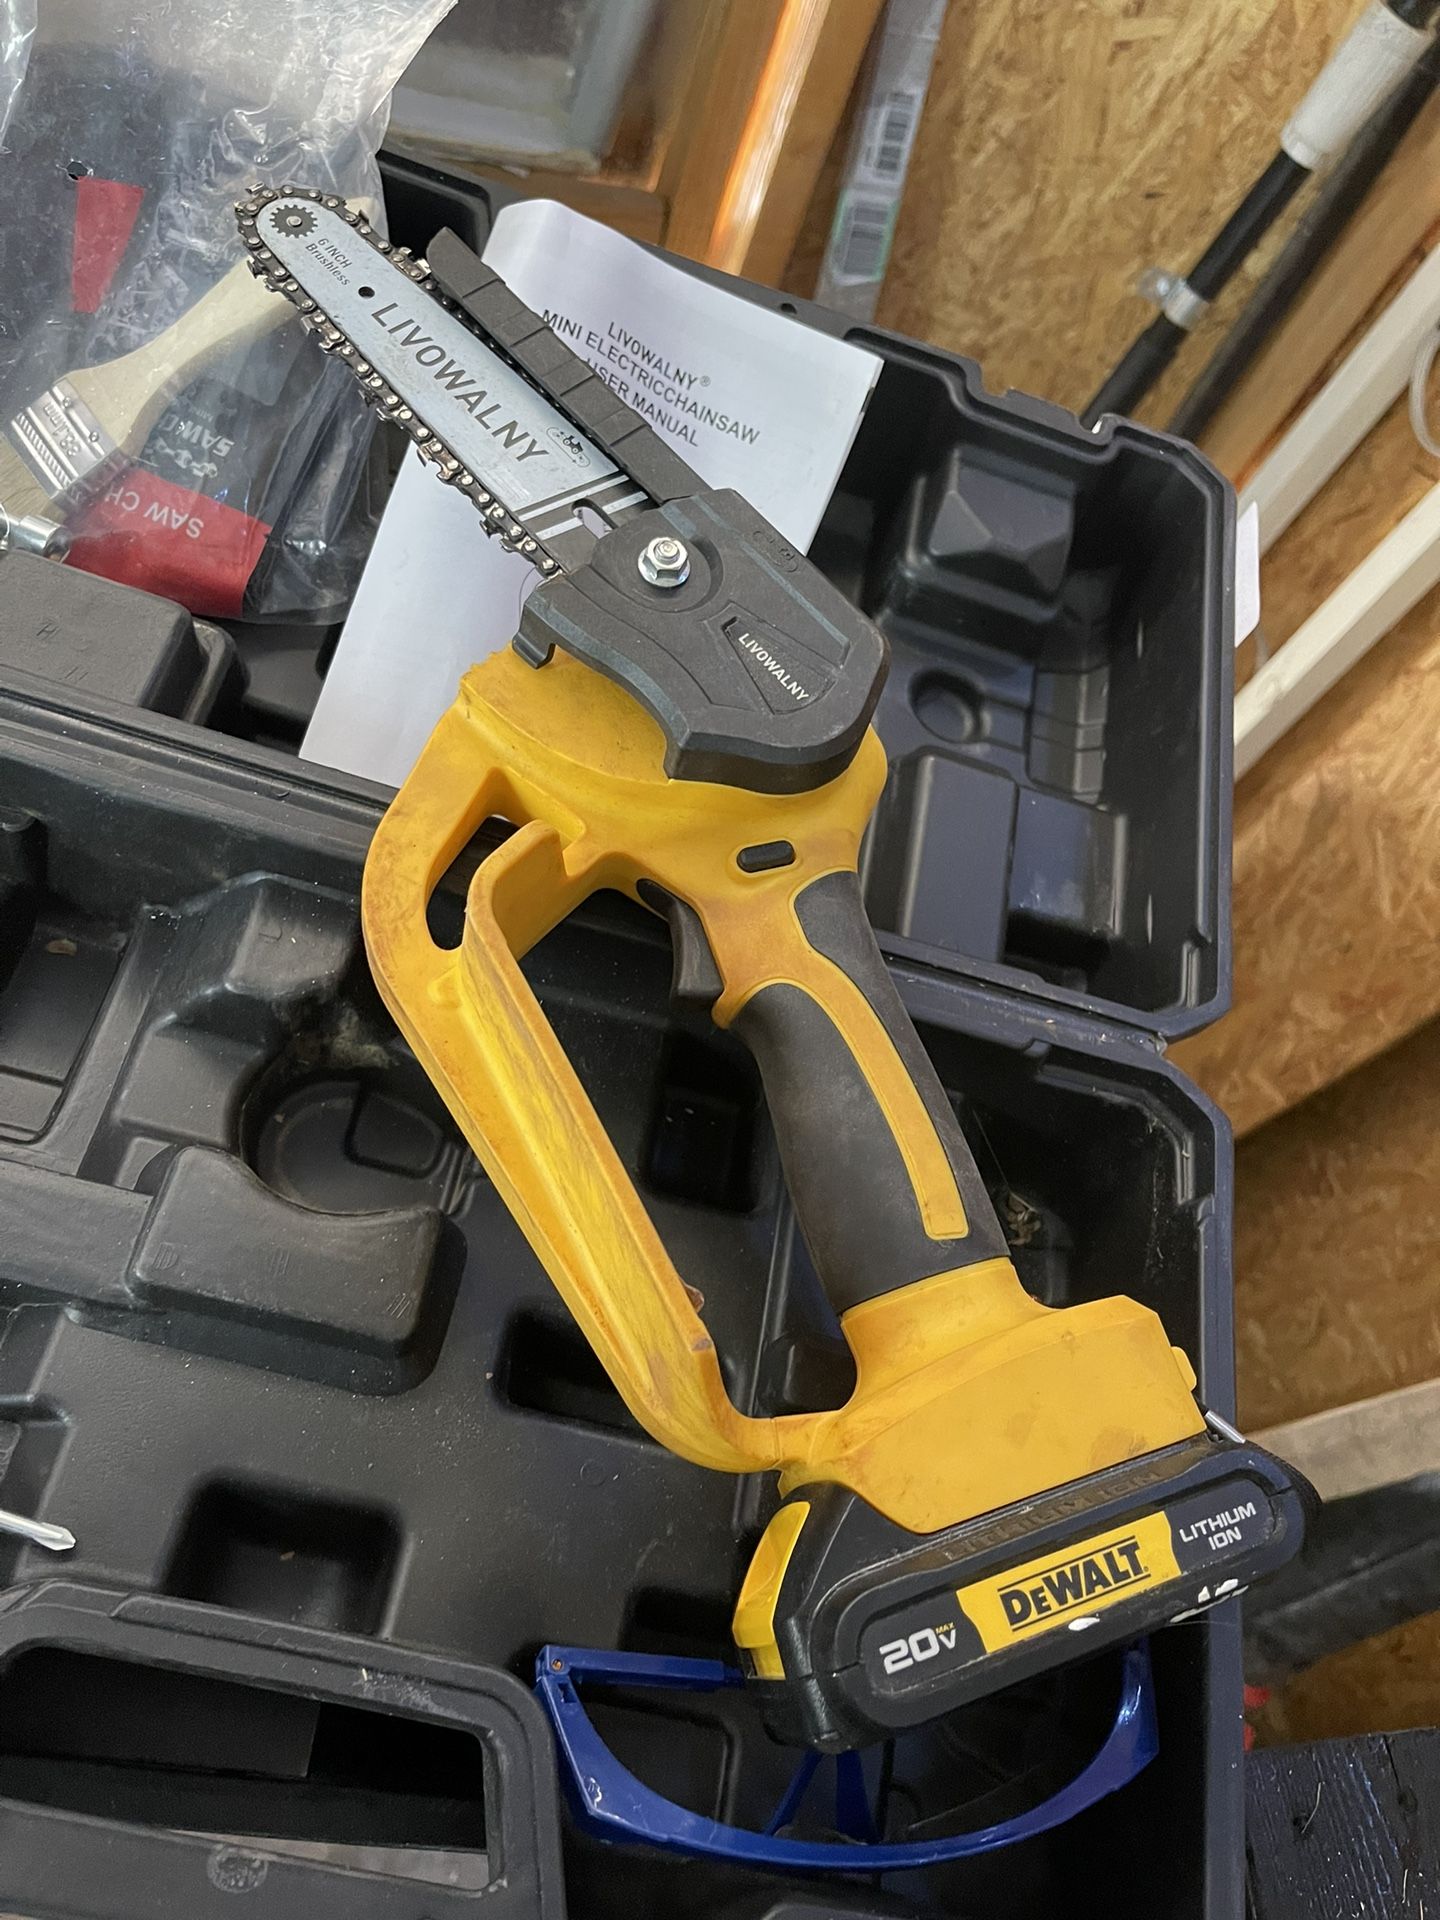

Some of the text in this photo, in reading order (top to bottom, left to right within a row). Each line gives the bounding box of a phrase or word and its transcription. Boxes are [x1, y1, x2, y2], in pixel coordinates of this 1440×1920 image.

[305, 243, 351, 286] Brushless
[318, 238, 352, 268] 6 INCH
[371, 302, 549, 462] LIVOWALNY
[543, 309, 760, 445] MINI ELECTRICCHAINSAW
[632, 392, 699, 446] MANUAL
[104, 485, 204, 539] SAW CH
[738, 633, 809, 700] LIVOWALNY
[1179, 1501, 1257, 1543] LITHIUM
[1208, 1526, 1242, 1550] ION
[935, 1622, 955, 1636] MAX
